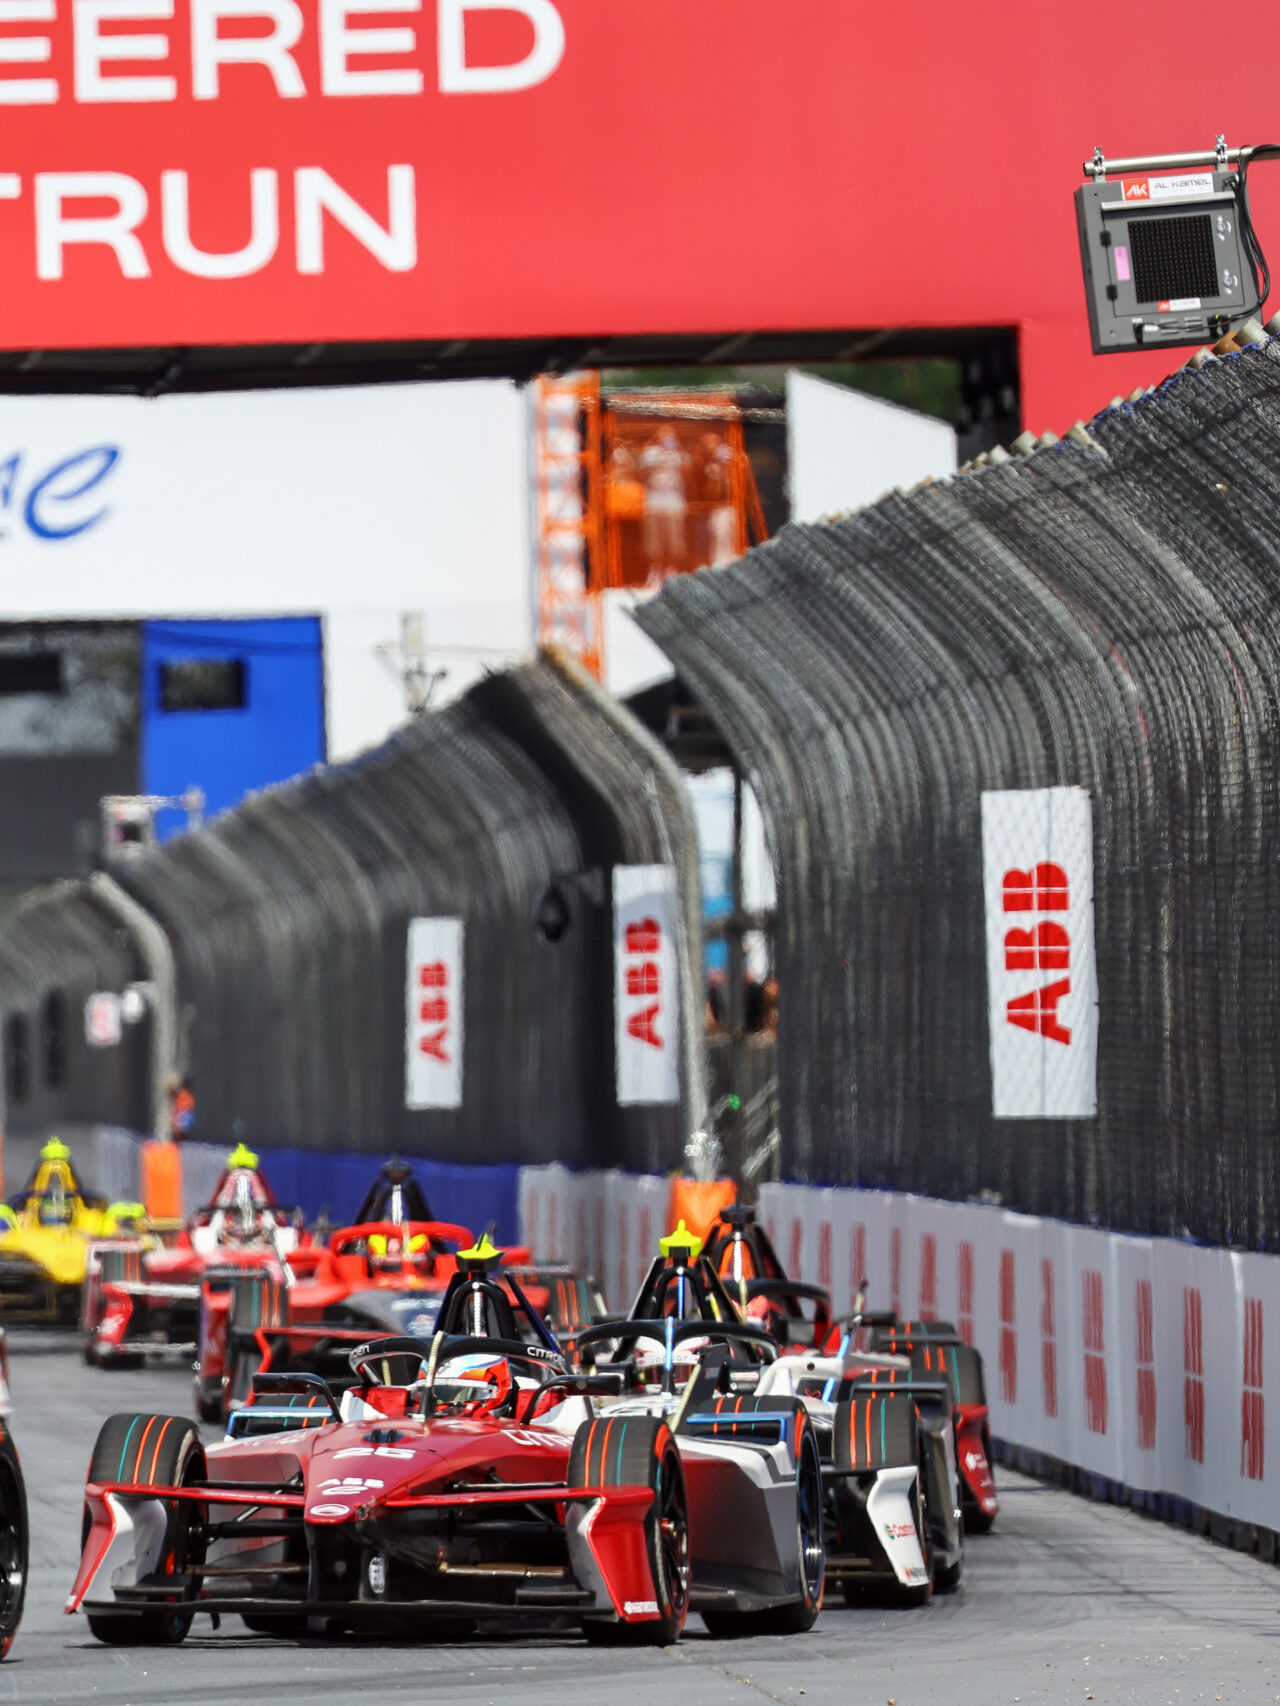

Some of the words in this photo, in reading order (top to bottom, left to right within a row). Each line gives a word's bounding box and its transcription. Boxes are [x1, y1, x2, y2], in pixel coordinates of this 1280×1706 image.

[418, 960, 453, 1065] ABB
[625, 915, 665, 1051] ABB
[1001, 860, 1073, 1045] ABB
